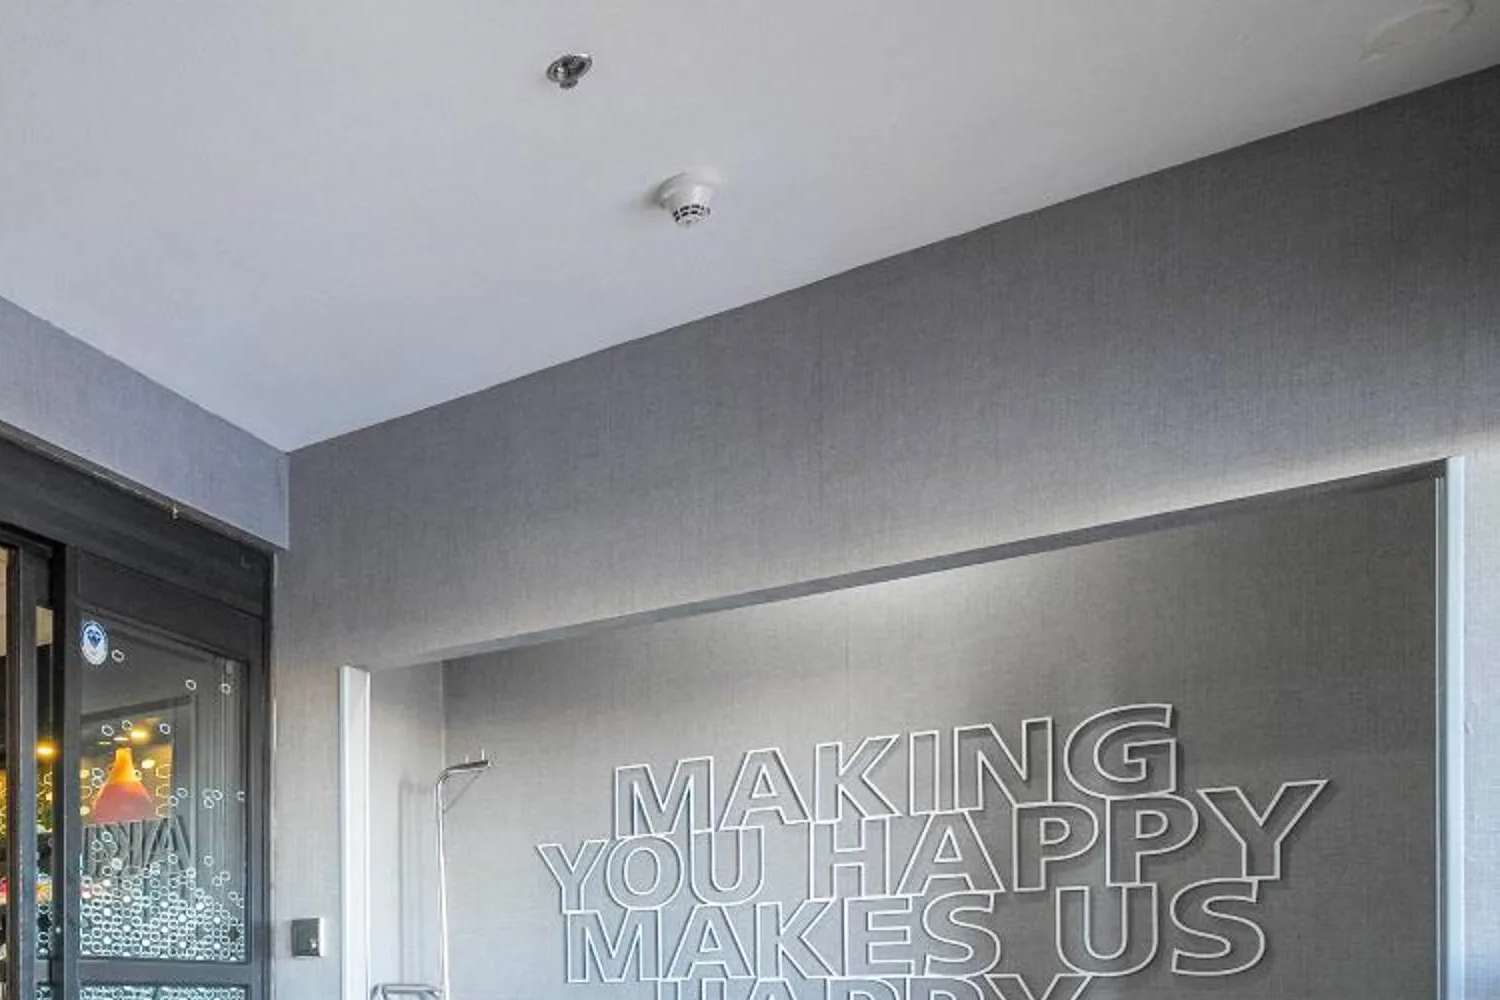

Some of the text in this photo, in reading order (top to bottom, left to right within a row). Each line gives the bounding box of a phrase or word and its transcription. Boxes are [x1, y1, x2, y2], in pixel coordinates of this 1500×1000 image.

[614, 702, 1179, 839] MAKING
[535, 778, 1330, 912] YOU HAPPY
[565, 877, 1267, 983] MAKES US
